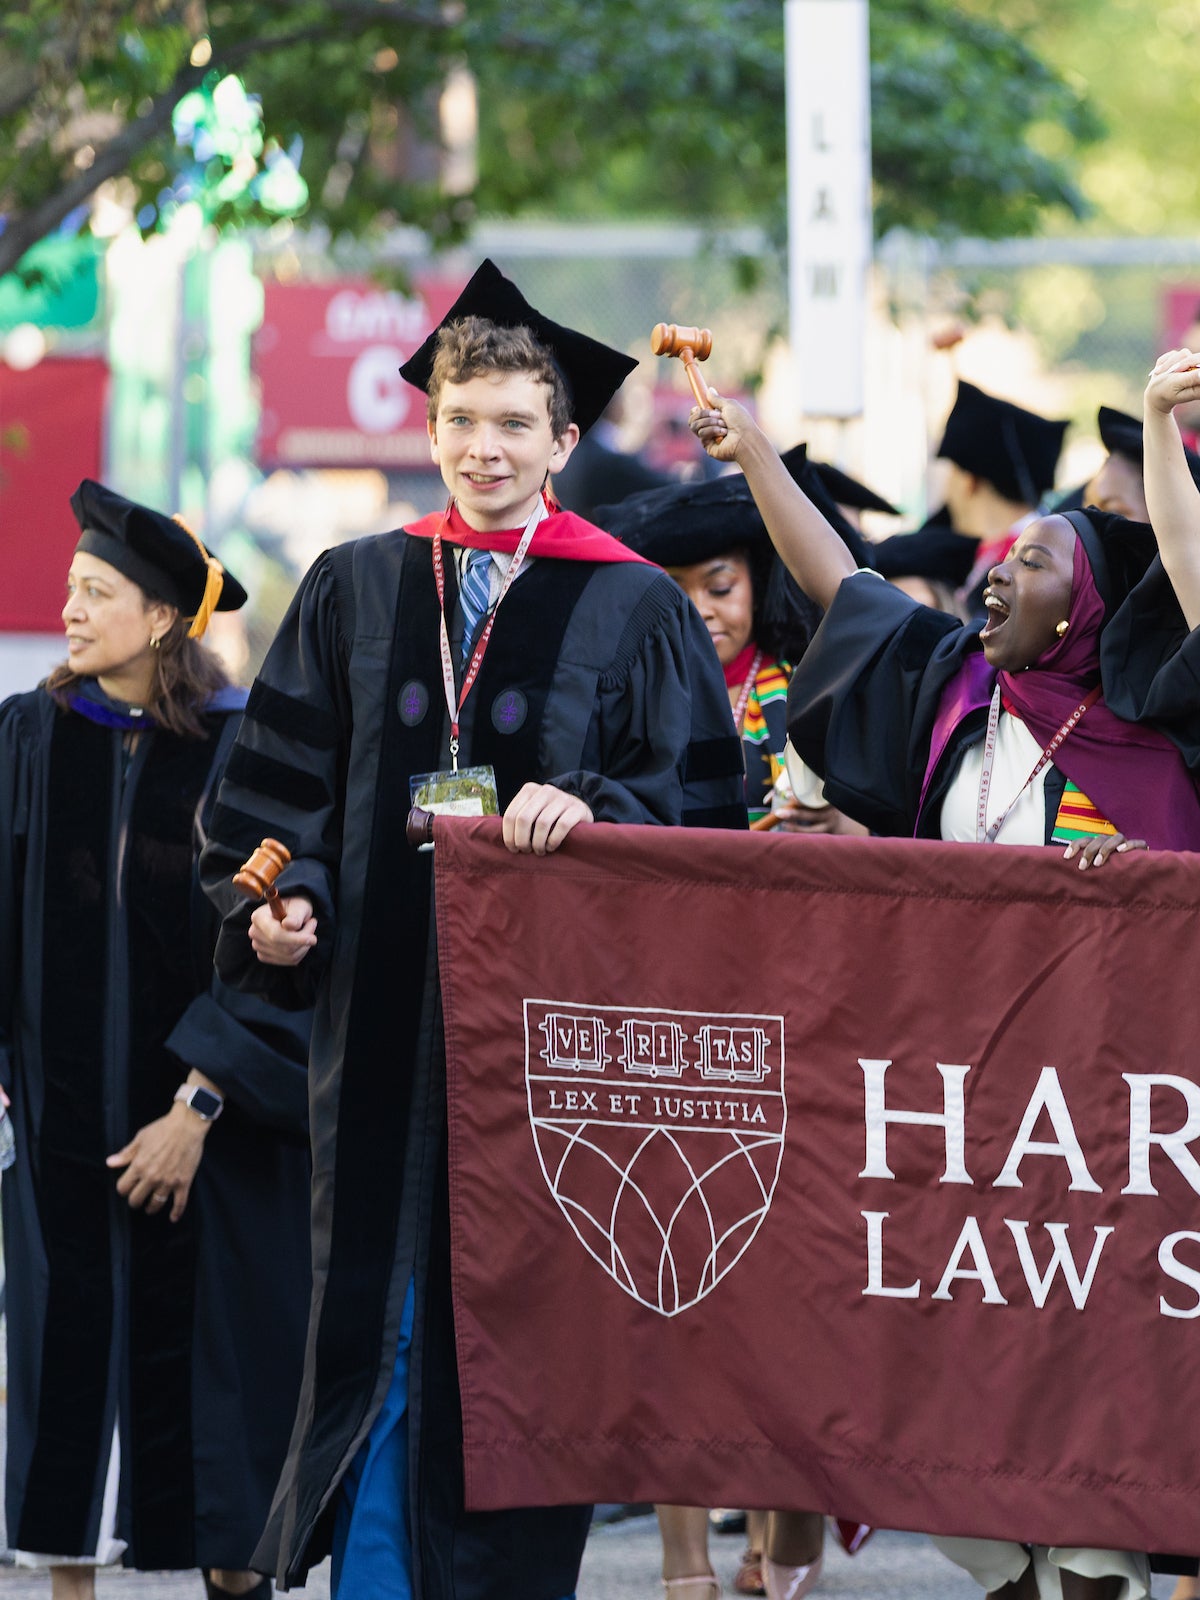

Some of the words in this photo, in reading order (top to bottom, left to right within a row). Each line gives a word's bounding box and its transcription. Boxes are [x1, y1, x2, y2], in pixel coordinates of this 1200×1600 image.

[808, 112, 843, 298] LAW
[466, 653, 482, 684] 2026
[558, 1028, 591, 1051] VE
[637, 1034, 667, 1057] RI
[712, 1038, 751, 1062] TAS
[549, 1090, 598, 1111] LEX
[609, 1094, 640, 1114] ET
[653, 1097, 766, 1123] IUSTITIA
[861, 1210, 1115, 1310] LAW
